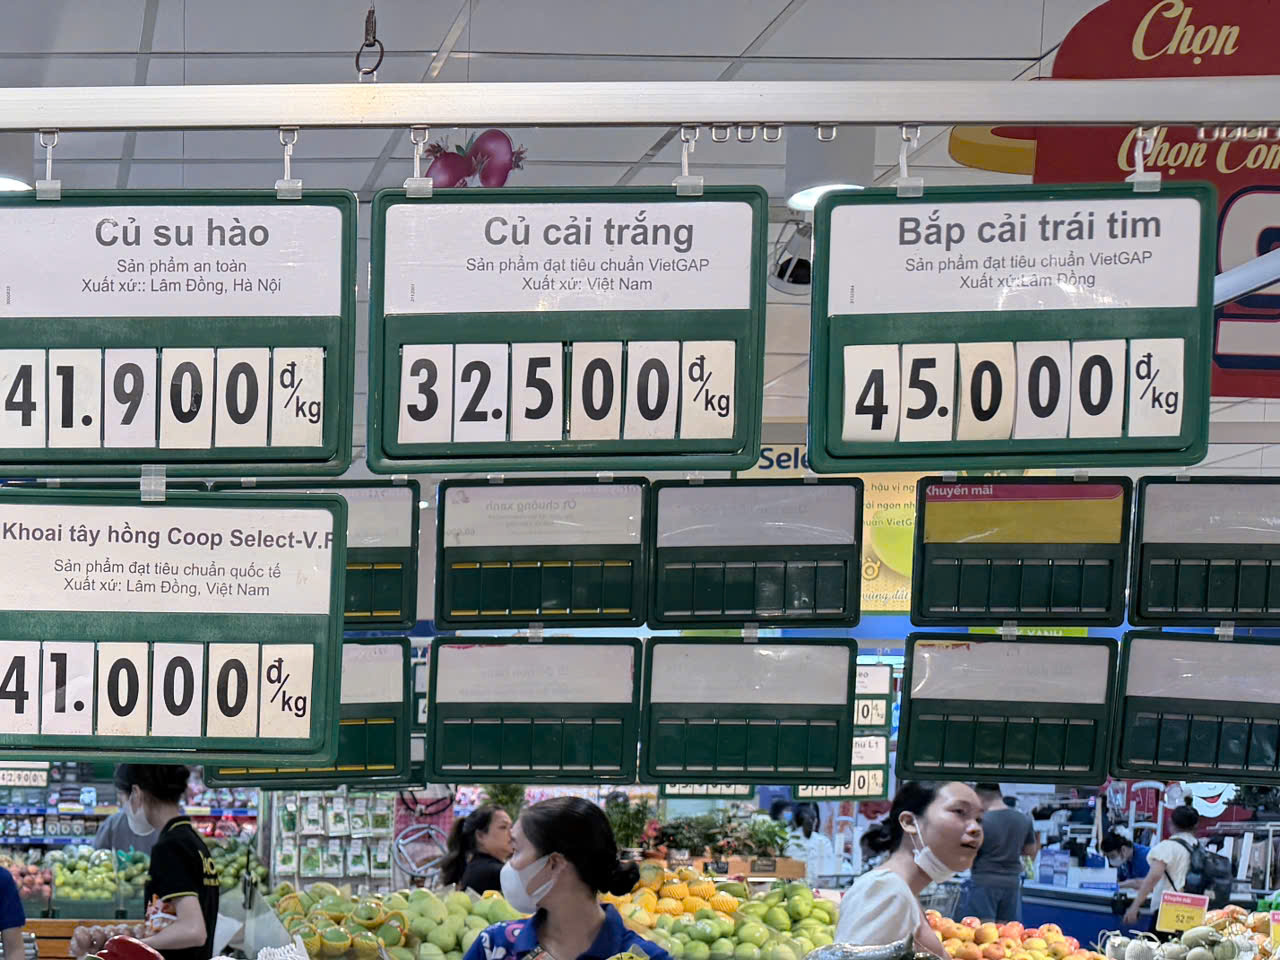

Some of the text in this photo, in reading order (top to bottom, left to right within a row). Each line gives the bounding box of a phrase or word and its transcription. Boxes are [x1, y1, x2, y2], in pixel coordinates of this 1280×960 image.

[1131, 0, 1240, 64] Chọn
[1117, 126, 1207, 175] Chọn
[95, 217, 270, 247] Củ su hào
[484, 210, 694, 253] Củ cải trắng
[899, 210, 1161, 252] Bắp cải trái tim
[117, 256, 247, 275] Sản phẩm an toàn
[905, 250, 1153, 275] Sản phẩm đạt tiêu chuẩn VietGAP
[81, 276, 115, 293] Xuất
[150, 278, 182, 292] Lâm
[185, 276, 228, 295] Đồng,
[233, 276, 253, 292] Hà
[257, 277, 282, 293] Nội
[522, 275, 653, 292] Xuất xứ: Việt Nam
[960, 273, 993, 290] Xuất
[1057, 271, 1096, 289] Đồng
[5, 361, 259, 428] 41.900
[406, 357, 670, 423] 32.500
[855, 354, 1113, 430] 45.000
[1, 522, 62, 543] Khoai
[70, 523, 100, 547] tây
[108, 519, 160, 548] hồng
[167, 527, 223, 549] Coop
[63, 576, 270, 598] Xuất xứ: Lâm Đồng, Việt Nam
